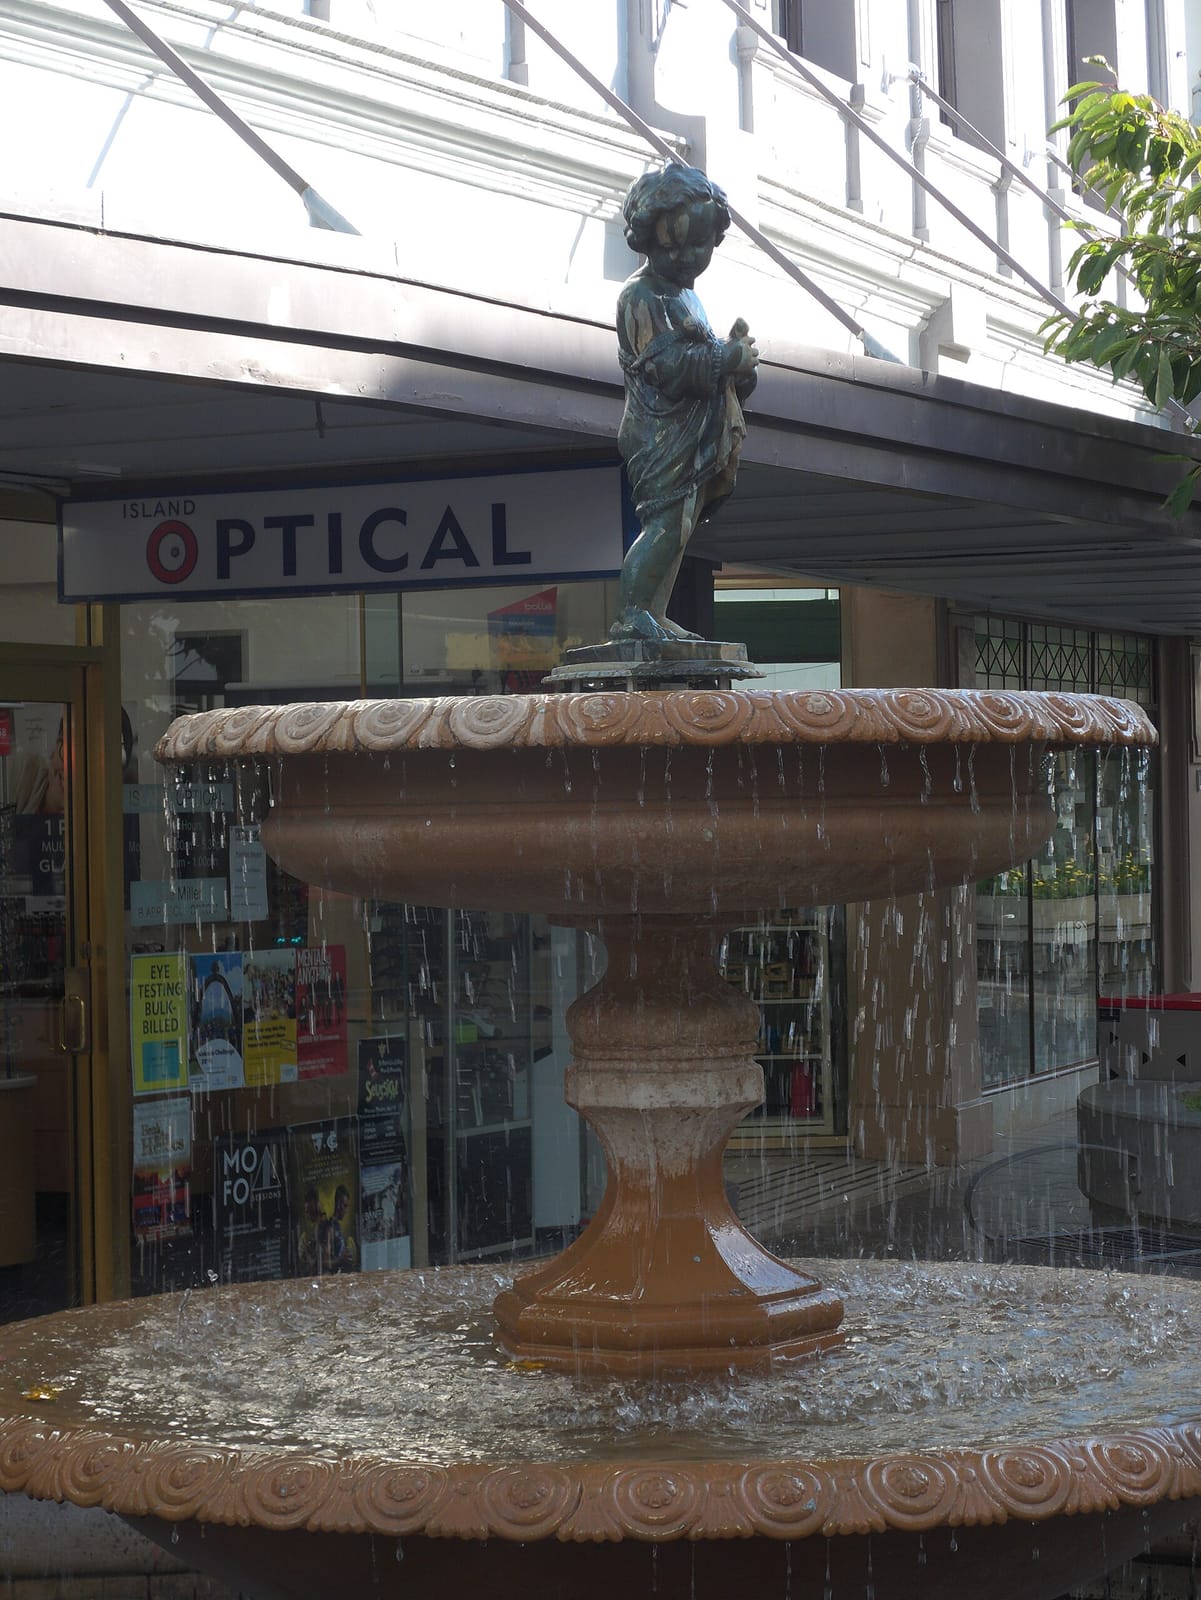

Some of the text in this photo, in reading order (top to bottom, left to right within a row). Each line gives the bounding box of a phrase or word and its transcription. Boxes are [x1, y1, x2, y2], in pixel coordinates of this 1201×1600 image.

[122, 500, 196, 519] ISLAND
[146, 503, 532, 585] OPTICAL
[150, 965, 171, 980] EYE
[138, 982, 182, 999] TESTING
[145, 1000, 176, 1016] BULK-
[142, 1017, 179, 1035] BILLED
[223, 1178, 250, 1207] FO
